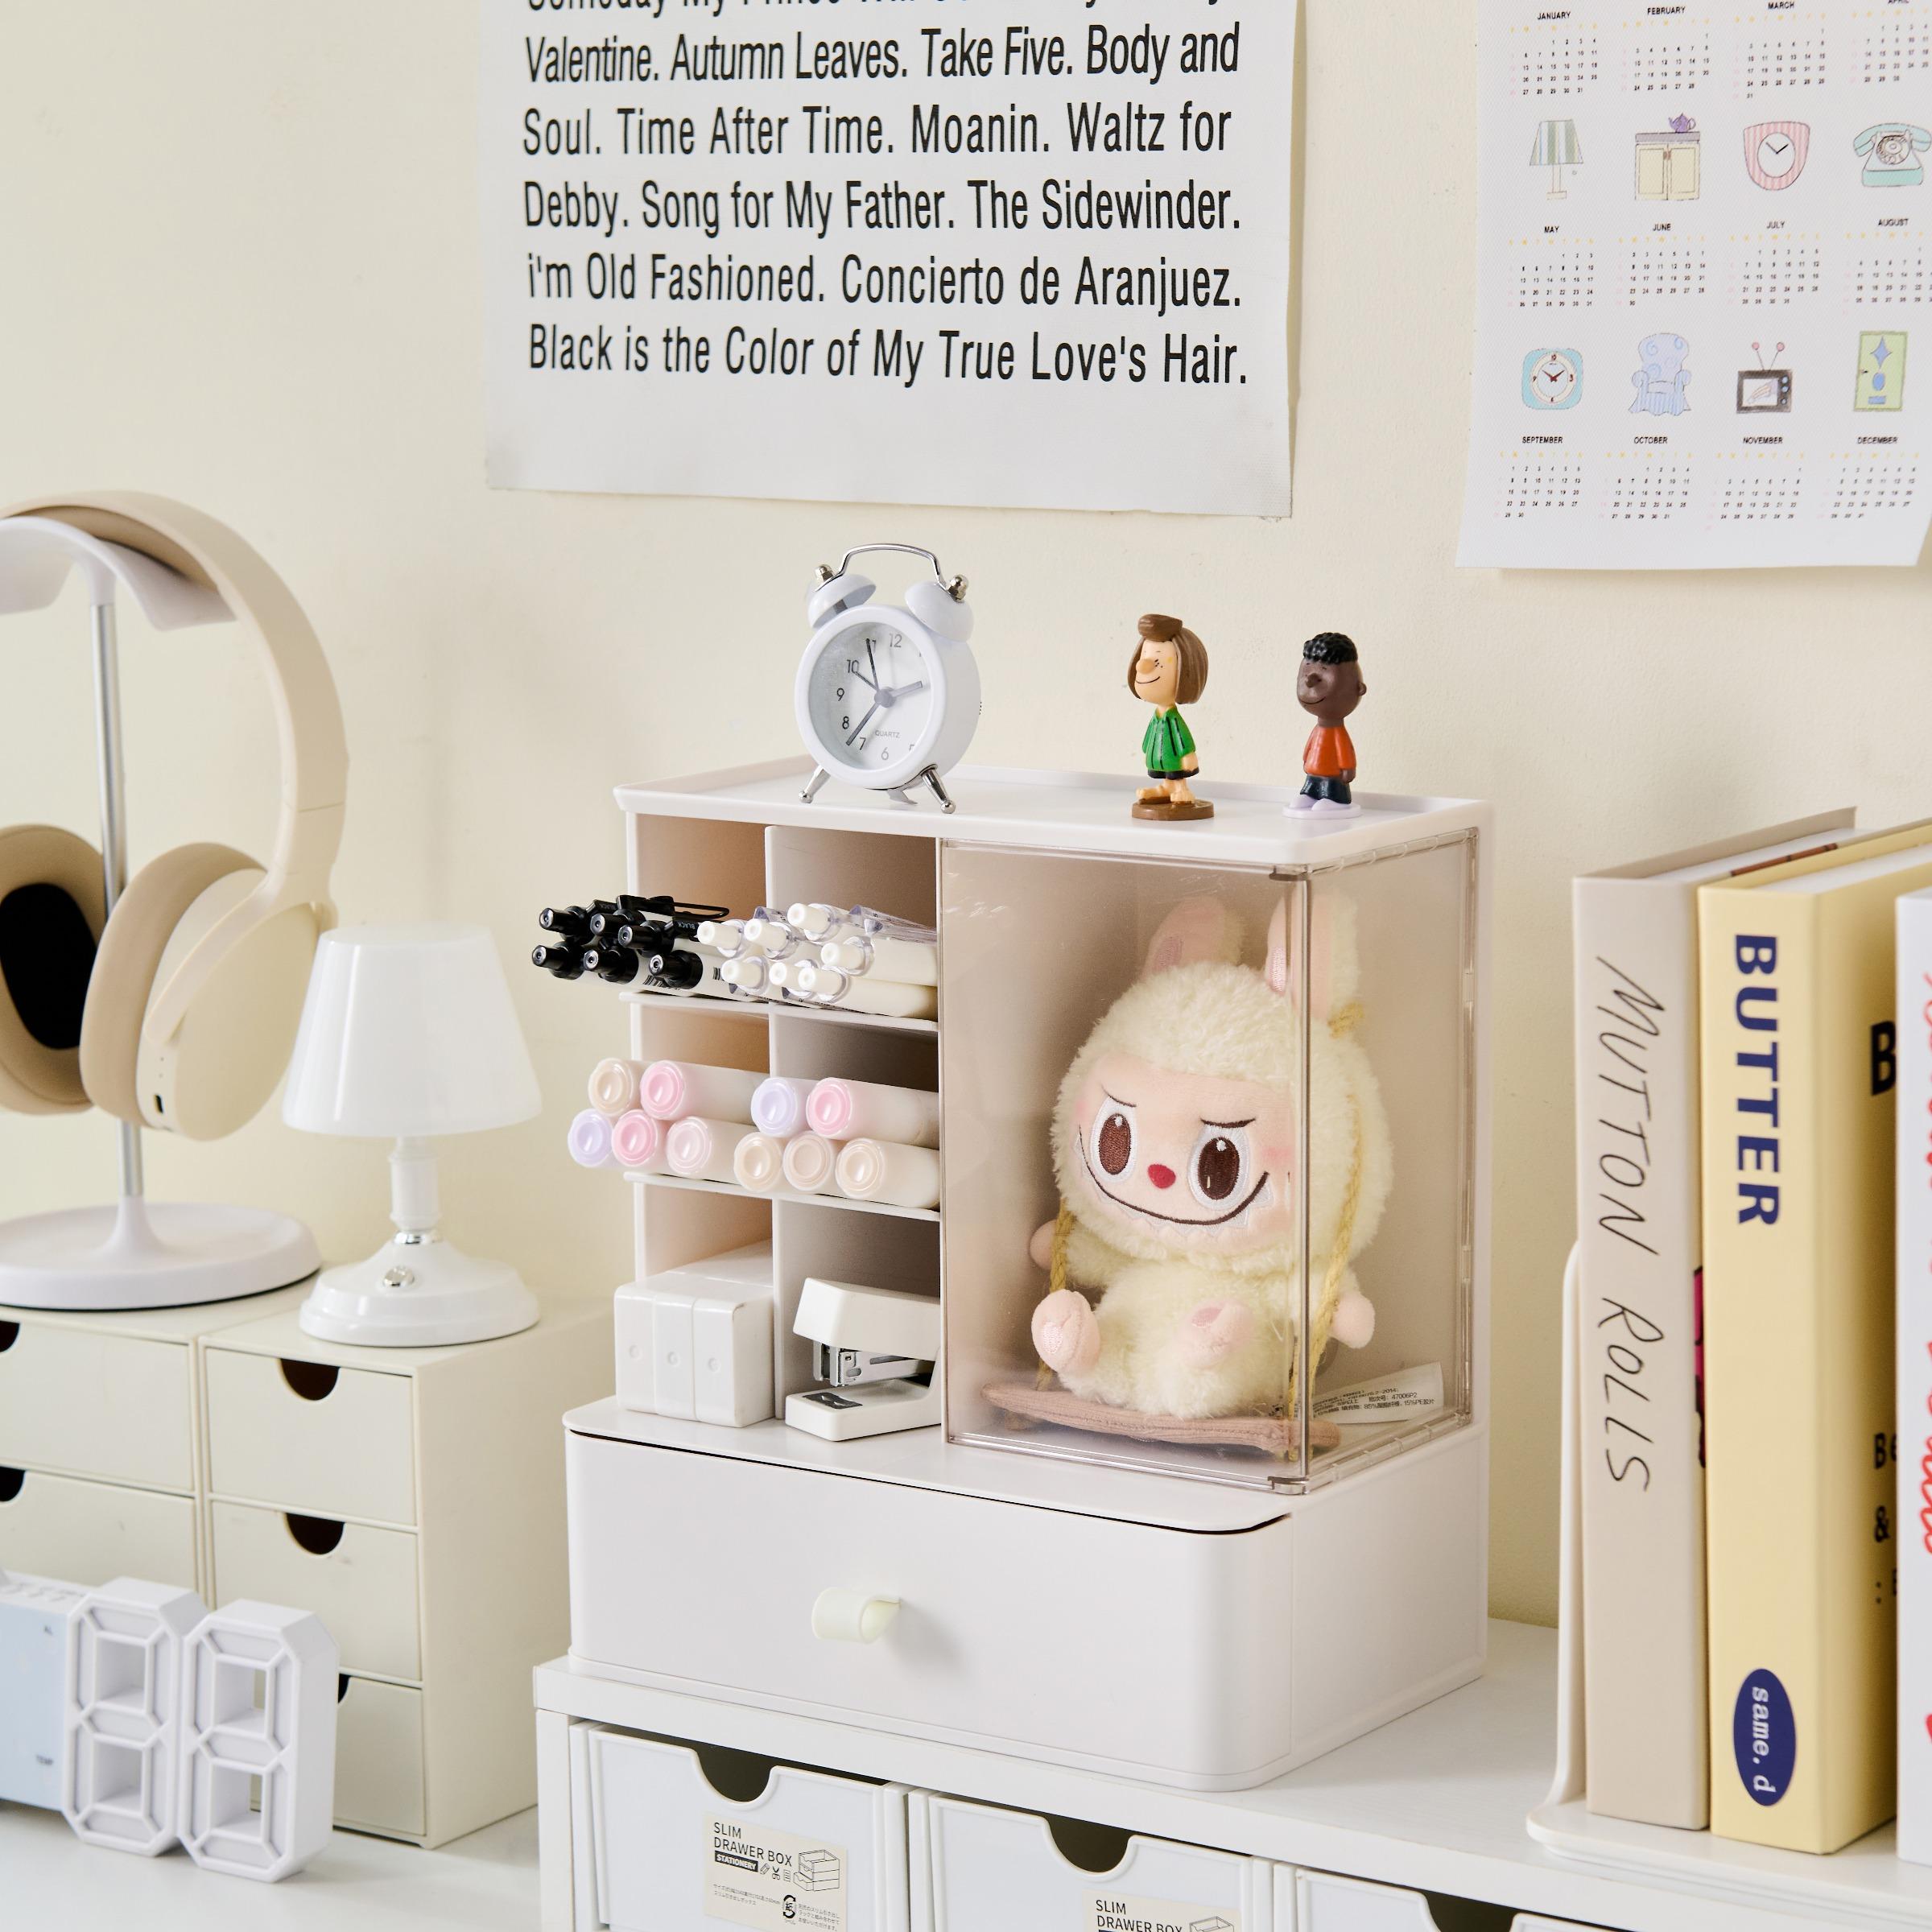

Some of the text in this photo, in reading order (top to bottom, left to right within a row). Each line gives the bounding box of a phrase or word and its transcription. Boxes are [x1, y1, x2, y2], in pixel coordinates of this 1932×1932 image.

[1648, 6, 1686, 15] FEBRUARY
[1768, 2, 1794, 10] MARCH
[1538, 11, 1571, 20] JANUARY
[526, 21, 1240, 85] Valentine. Autumn Leaves. Take Five. Body and
[523, 100, 1232, 155] Soul. Time After Time. Moanin. Waltz for
[524, 178, 1240, 239] Debby. Song for My Father. The Sidewinder.
[1653, 223, 1671, 231] JUNE
[1878, 218, 1909, 226] AUGUST
[528, 252, 1241, 317] i'm Old Fashioned. Concierto de Aranjuez.
[530, 324, 1246, 389] Black is the Color of My True Love's Hair.
[889, 634, 902, 649] 12
[836, 687, 844, 702] 9
[842, 716, 849, 730] 8
[874, 729, 901, 739] QUARTZ
[858, 737, 867, 751] 7
[881, 746, 890, 762] 6
[1735, 934, 1780, 1227] BUTTER
[1596, 956, 1666, 1492] MUTTON ROLLS
[1751, 1685, 1777, 1794] same. d
[713, 1822, 741, 1839] SLIM
[714, 1836, 792, 1868] DRAWER BOX
[716, 1854, 757, 1872] STATIONERY
[1096, 1899, 1126, 1915] SLIM
[1096, 1914, 1152, 1932] DRAWER
